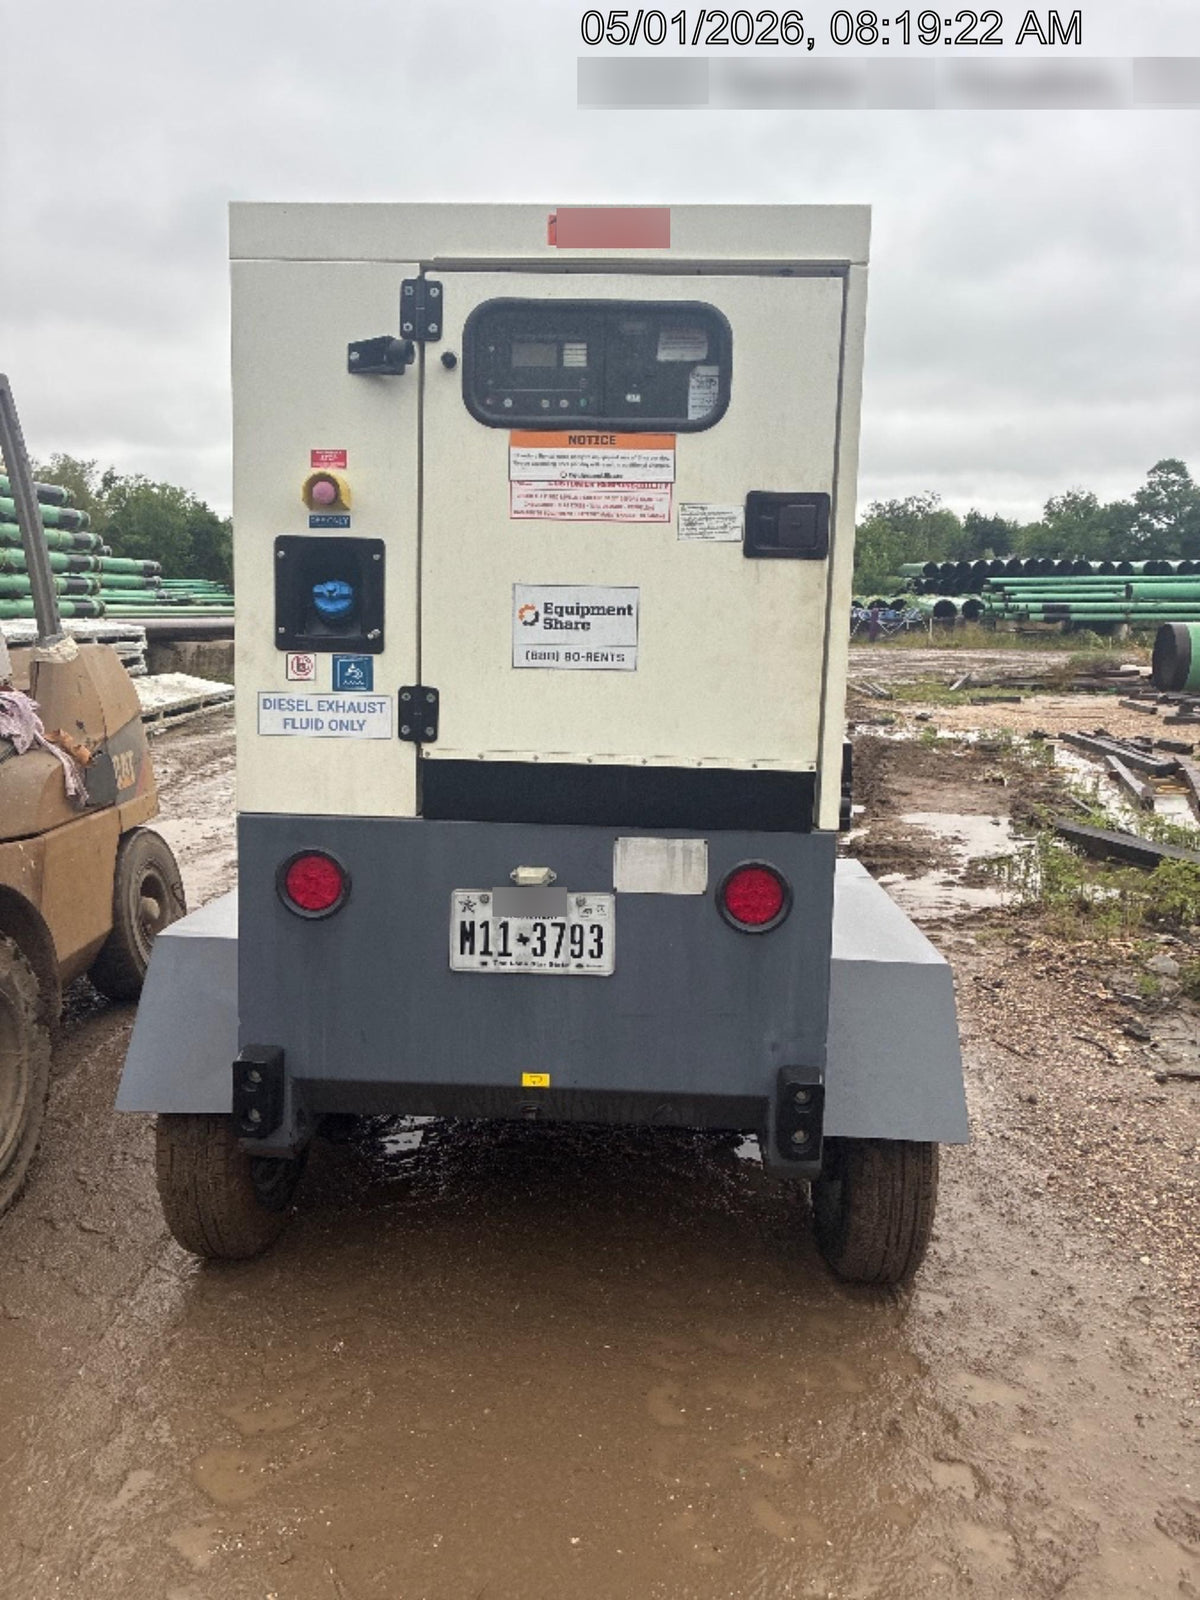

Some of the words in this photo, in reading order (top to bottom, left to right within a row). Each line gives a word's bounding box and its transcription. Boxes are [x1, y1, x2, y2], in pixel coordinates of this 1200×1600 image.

[568, 435, 617, 445] NOTICE
[543, 602, 633, 618] Equipment
[543, 618, 591, 631] Share
[262, 698, 313, 712] DIESEL
[317, 700, 386, 714] EXHAUST
[283, 717, 324, 731] FLUID
[328, 719, 366, 732] ONLY
[459, 920, 513, 957] M11
[531, 922, 604, 959] 3793
